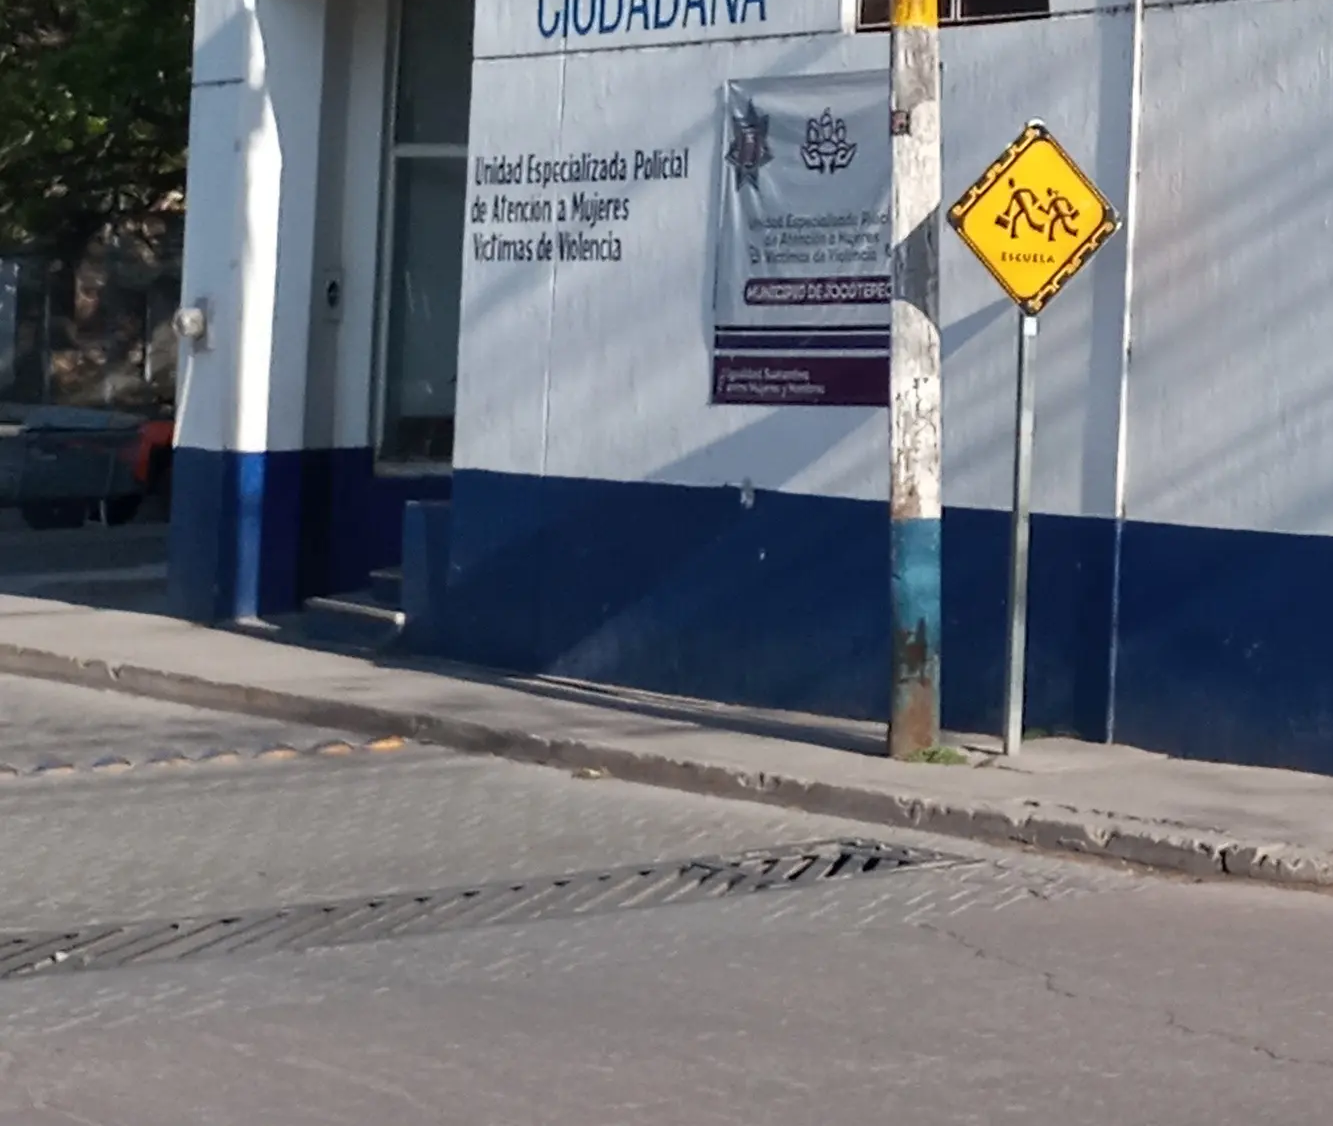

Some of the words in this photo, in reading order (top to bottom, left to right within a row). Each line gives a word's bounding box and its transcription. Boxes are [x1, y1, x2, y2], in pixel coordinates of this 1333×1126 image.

[475, 154, 523, 186] Unidad
[527, 150, 628, 189] Especializada
[634, 147, 690, 180] Policial
[471, 194, 486, 224] de
[556, 197, 567, 222] a
[571, 191, 630, 228] Mujeres
[537, 231, 553, 261] de
[558, 230, 623, 262] Violencia
[1000, 251, 1055, 264] ESCUELA
